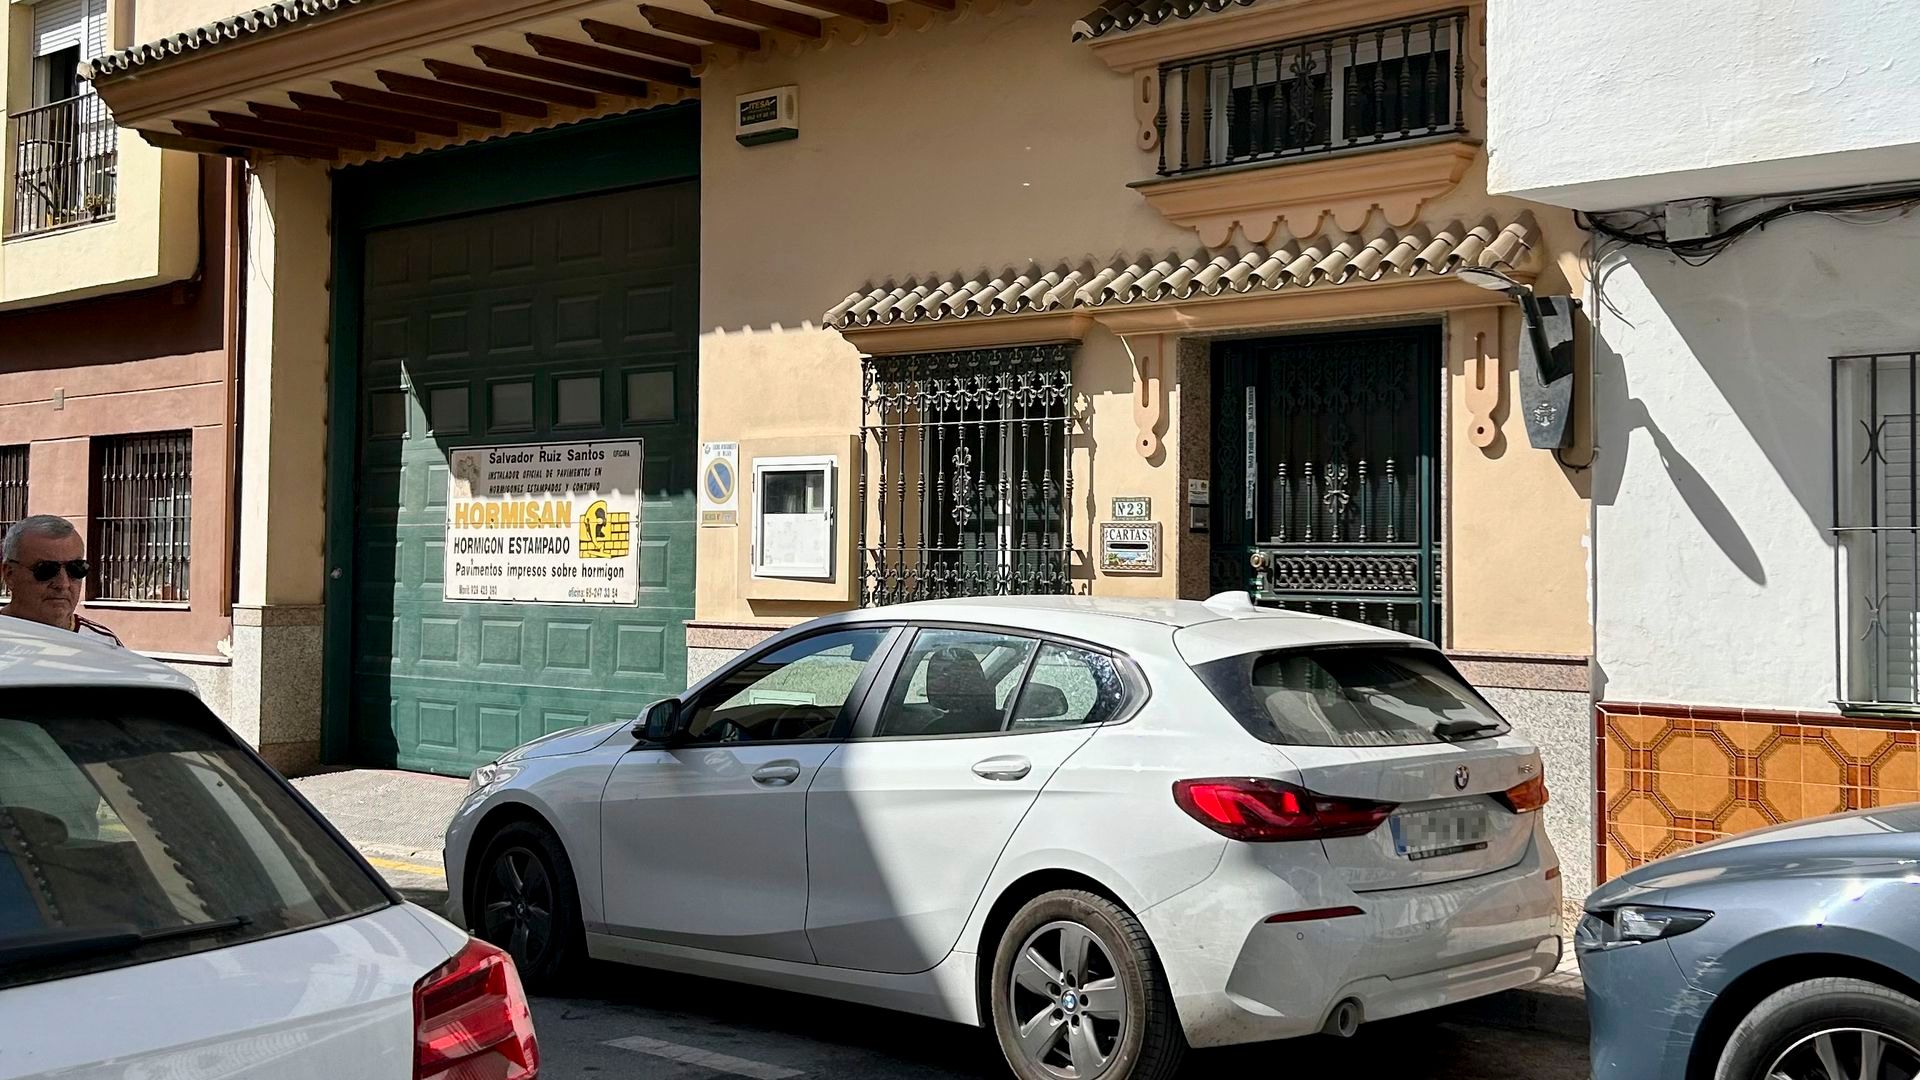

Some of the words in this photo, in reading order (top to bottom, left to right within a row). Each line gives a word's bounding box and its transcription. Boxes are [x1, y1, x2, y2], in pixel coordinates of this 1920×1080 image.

[489, 452, 534, 464] Salvador
[539, 450, 562, 463] Ruiz
[567, 449, 605, 461] Santos
[488, 470, 519, 480] INSTALADOR
[523, 469, 542, 479] OFICIAL
[546, 469, 553, 478] DE
[557, 468, 591, 477] PAVIMENTOS
[595, 467, 603, 476] EN
[489, 484, 524, 494] HORMIGONES
[527, 483, 562, 493] ESTAMPADOS
[455, 501, 572, 529] HORMISAN
[1109, 529, 1148, 541] CARTAS
[454, 537, 504, 554] HORMIGON
[509, 536, 570, 554] ESTAMPADO
[456, 559, 503, 576] Pavimentos
[507, 562, 547, 580] impresos
[551, 563, 577, 578] sobre
[582, 563, 624, 581] hormigon
